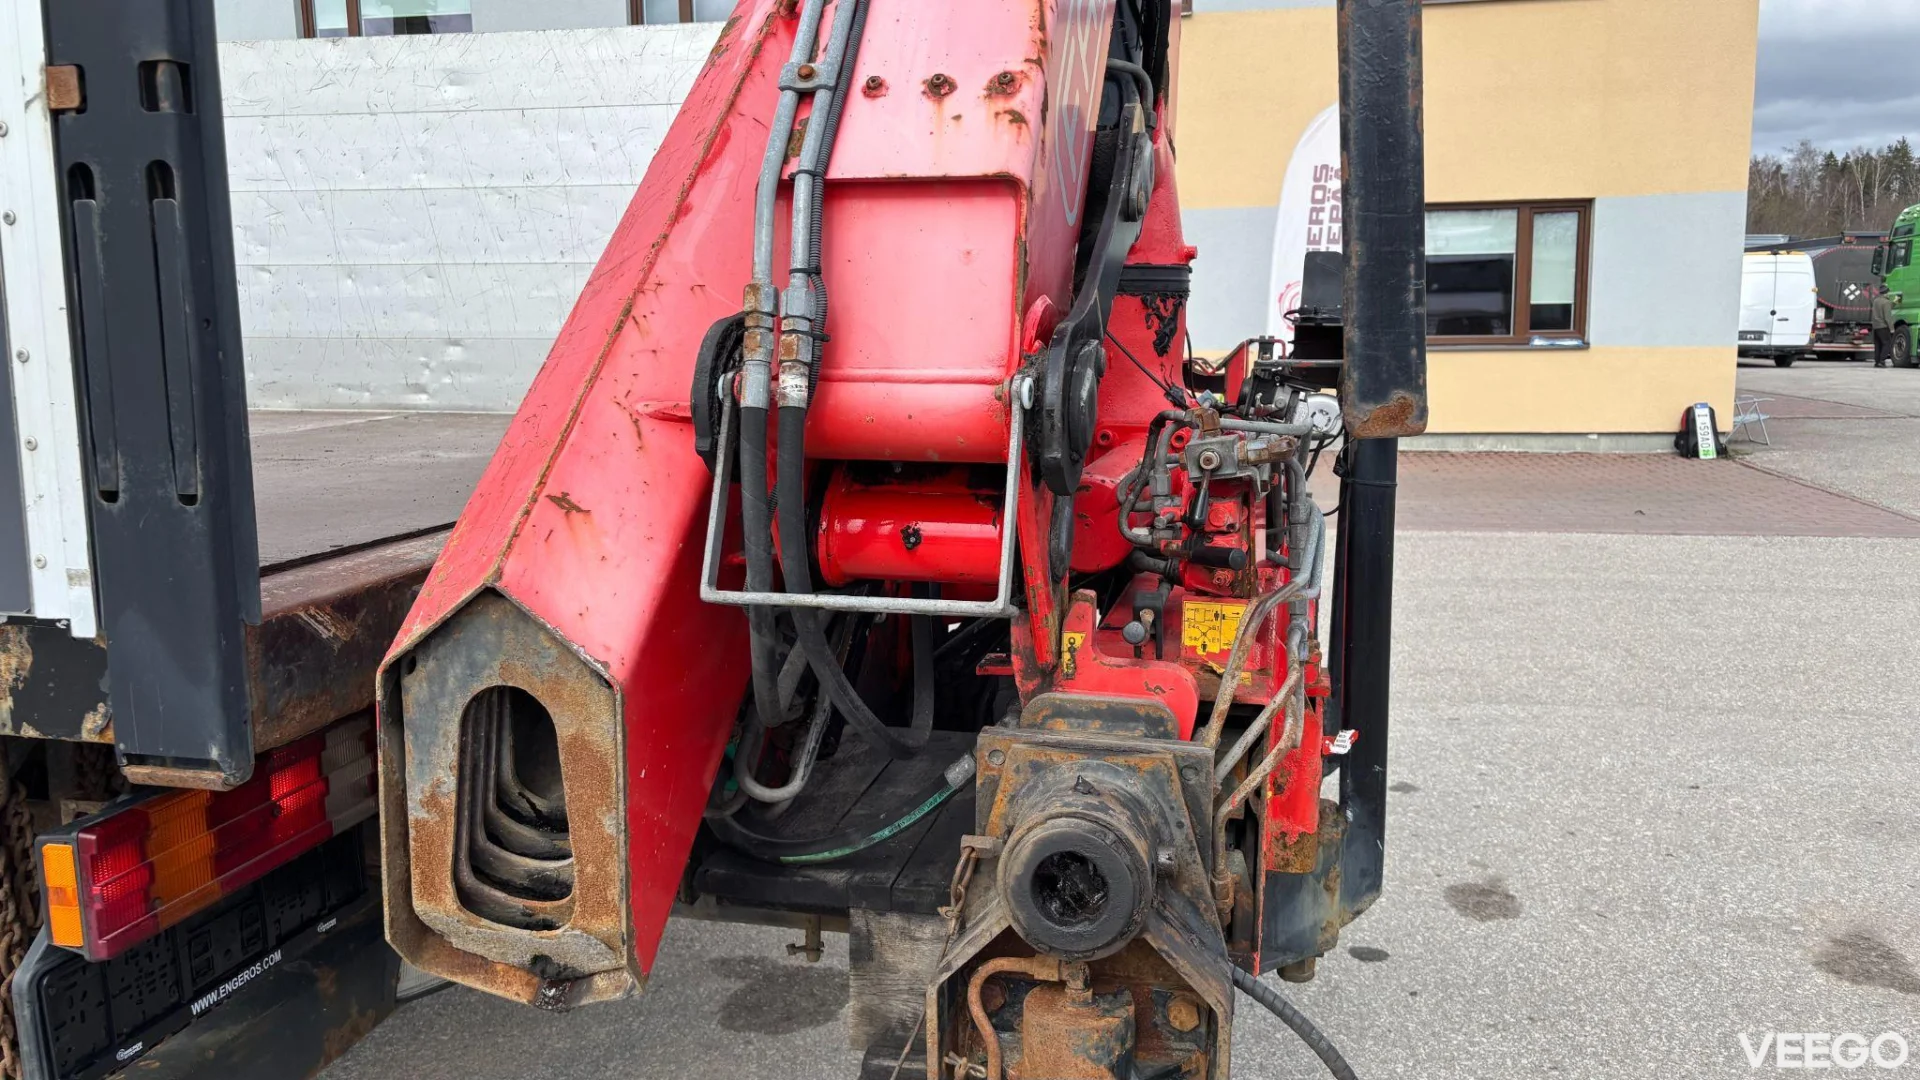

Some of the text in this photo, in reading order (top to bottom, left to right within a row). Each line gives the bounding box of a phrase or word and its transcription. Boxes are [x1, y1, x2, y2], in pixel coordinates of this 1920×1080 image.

[1306, 164, 1329, 252] EROS
[1325, 166, 1342, 251] EPÄÄ
[190, 948, 283, 1016] WWW.ENGEROS.COM
